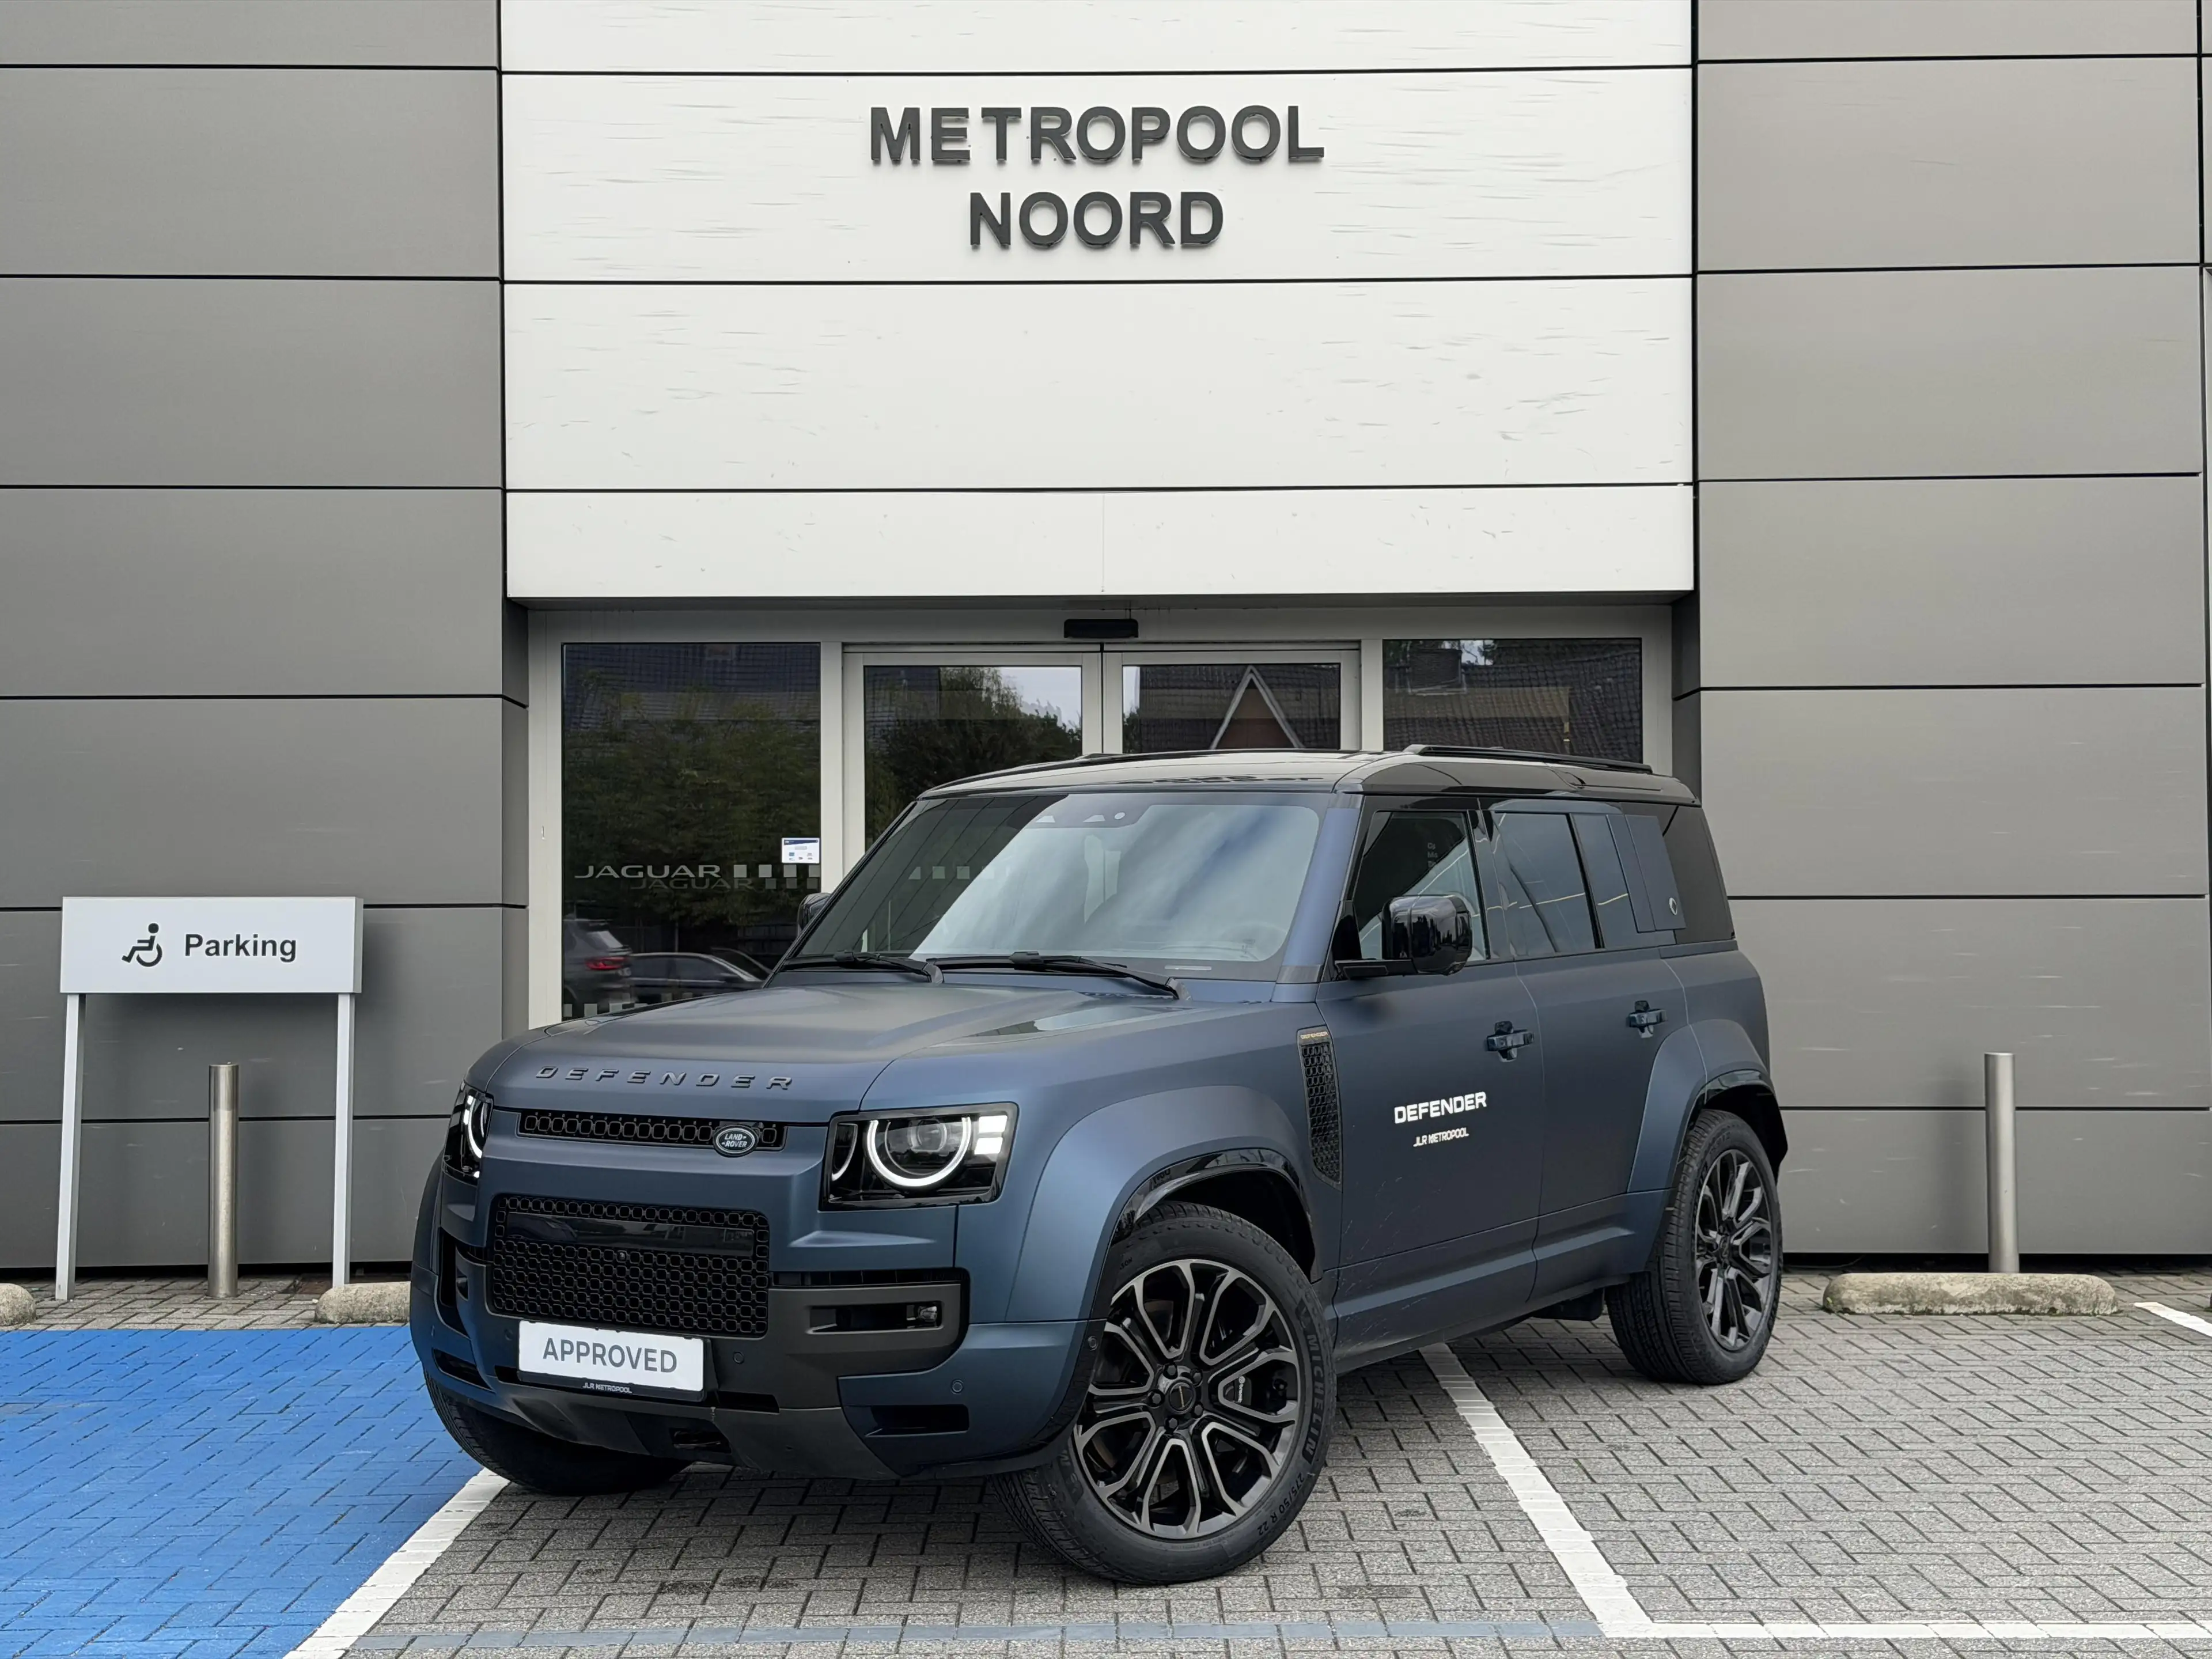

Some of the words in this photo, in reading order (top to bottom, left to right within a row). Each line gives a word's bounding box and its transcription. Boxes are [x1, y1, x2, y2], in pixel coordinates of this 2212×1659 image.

[870, 105, 1325, 162] METROPOOL
[970, 191, 1224, 247] NOORD
[574, 865, 721, 878] JAGUAR
[185, 934, 297, 963] Parking
[536, 1065, 793, 1090] DEFENDER
[1394, 1091, 1487, 1124] DEFENDER
[1413, 1135, 1427, 1147] JLR
[1428, 1127, 1469, 1144] METROPOOL
[542, 1337, 677, 1373] APPROVED
[595, 1384, 632, 1394] METROPOOL
[1306, 1334, 1324, 1457] MICHELIN
[1278, 1473, 1305, 1514] 275/50
[1257, 1522, 1269, 1536] 22
[1270, 1514, 1278, 1524] R
